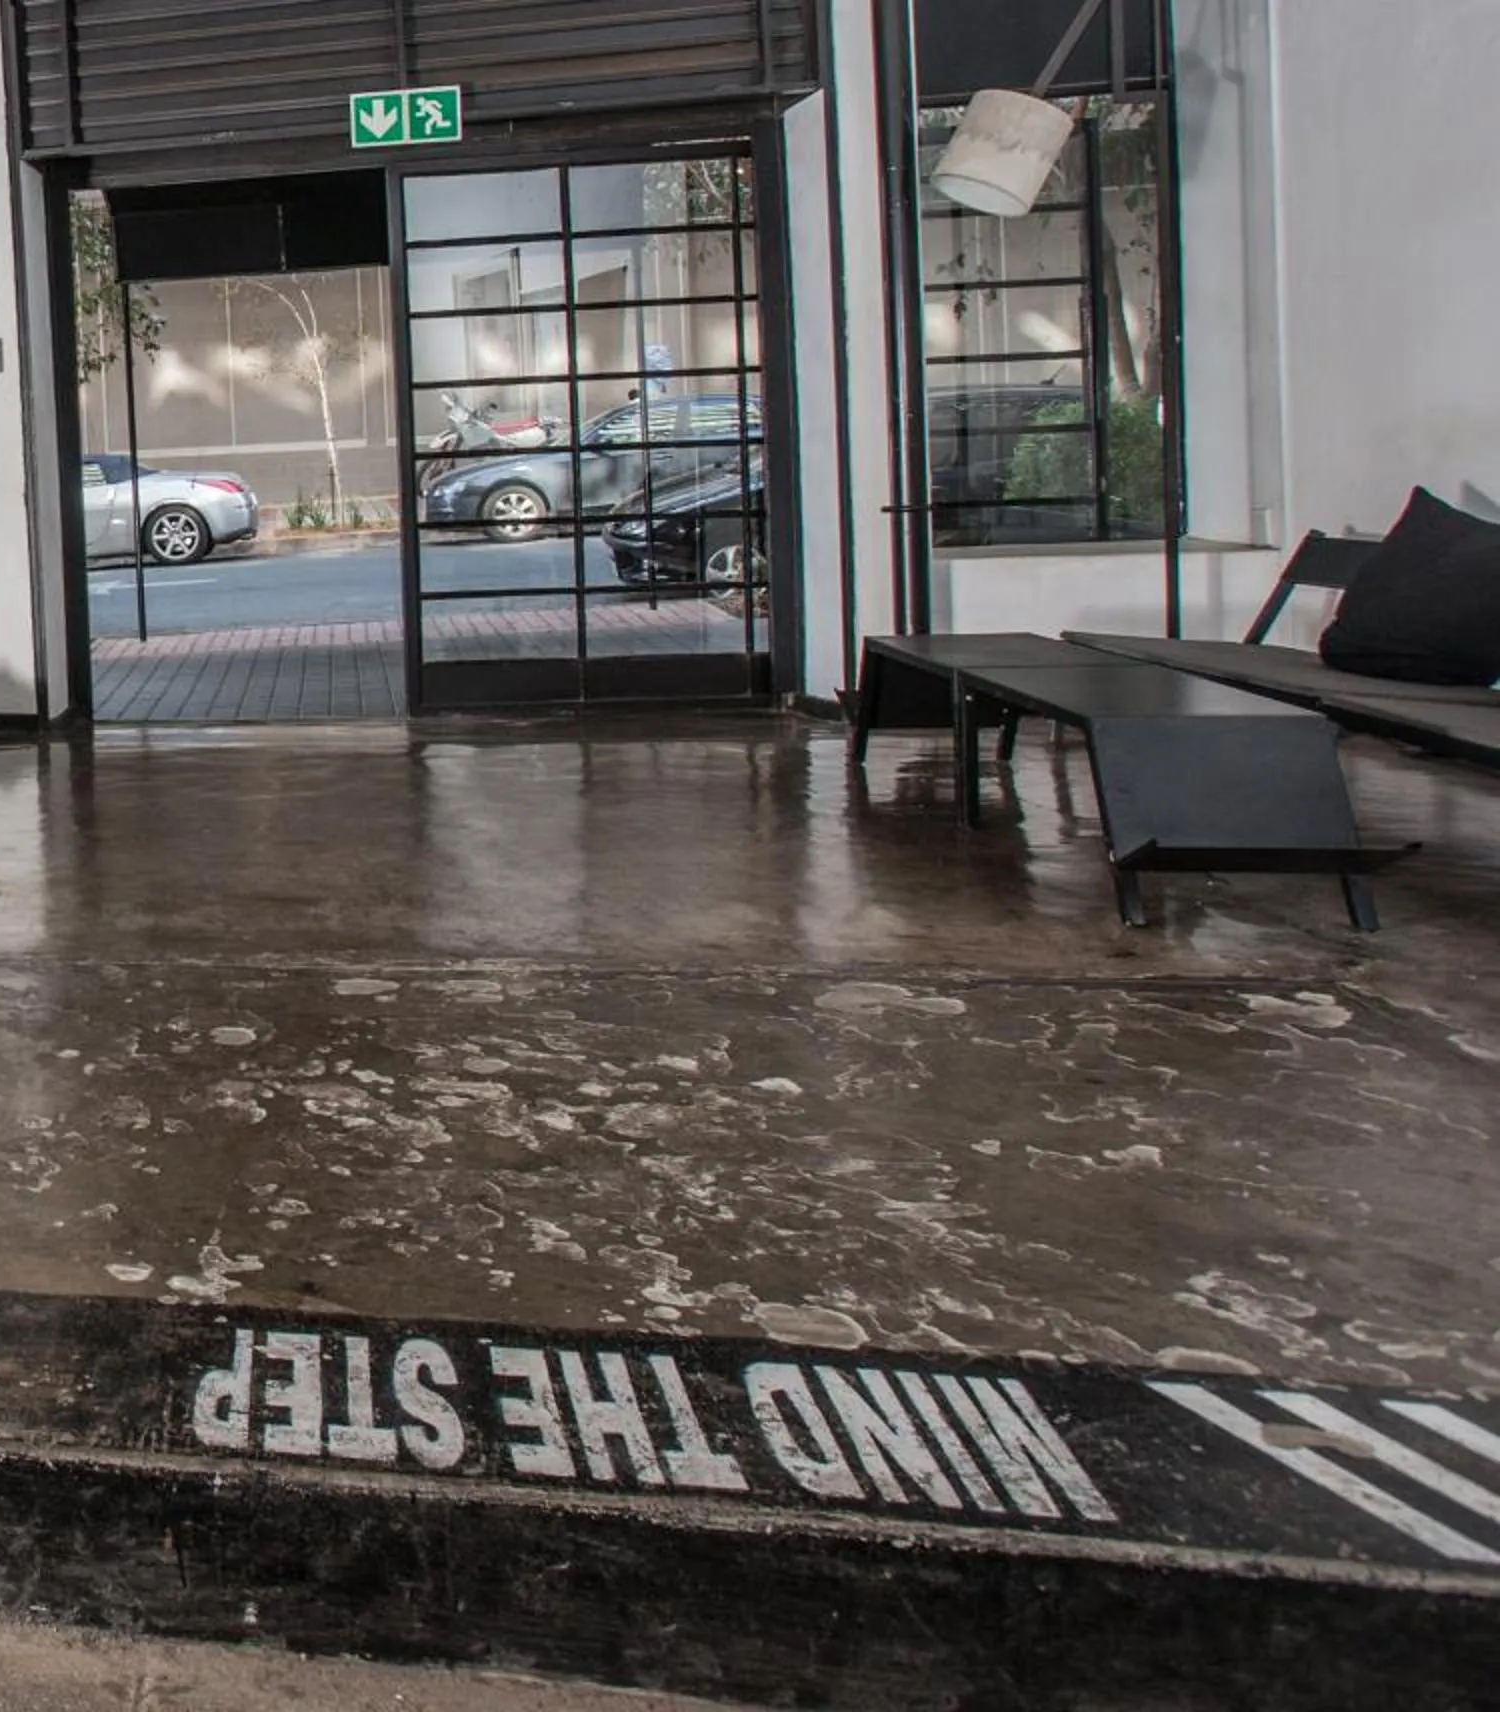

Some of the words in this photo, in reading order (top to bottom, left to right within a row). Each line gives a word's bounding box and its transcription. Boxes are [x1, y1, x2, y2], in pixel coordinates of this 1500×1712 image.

[193, 1329, 466, 1469] STEP
[490, 1346, 751, 1491] THE
[745, 1361, 1119, 1521] MIND
